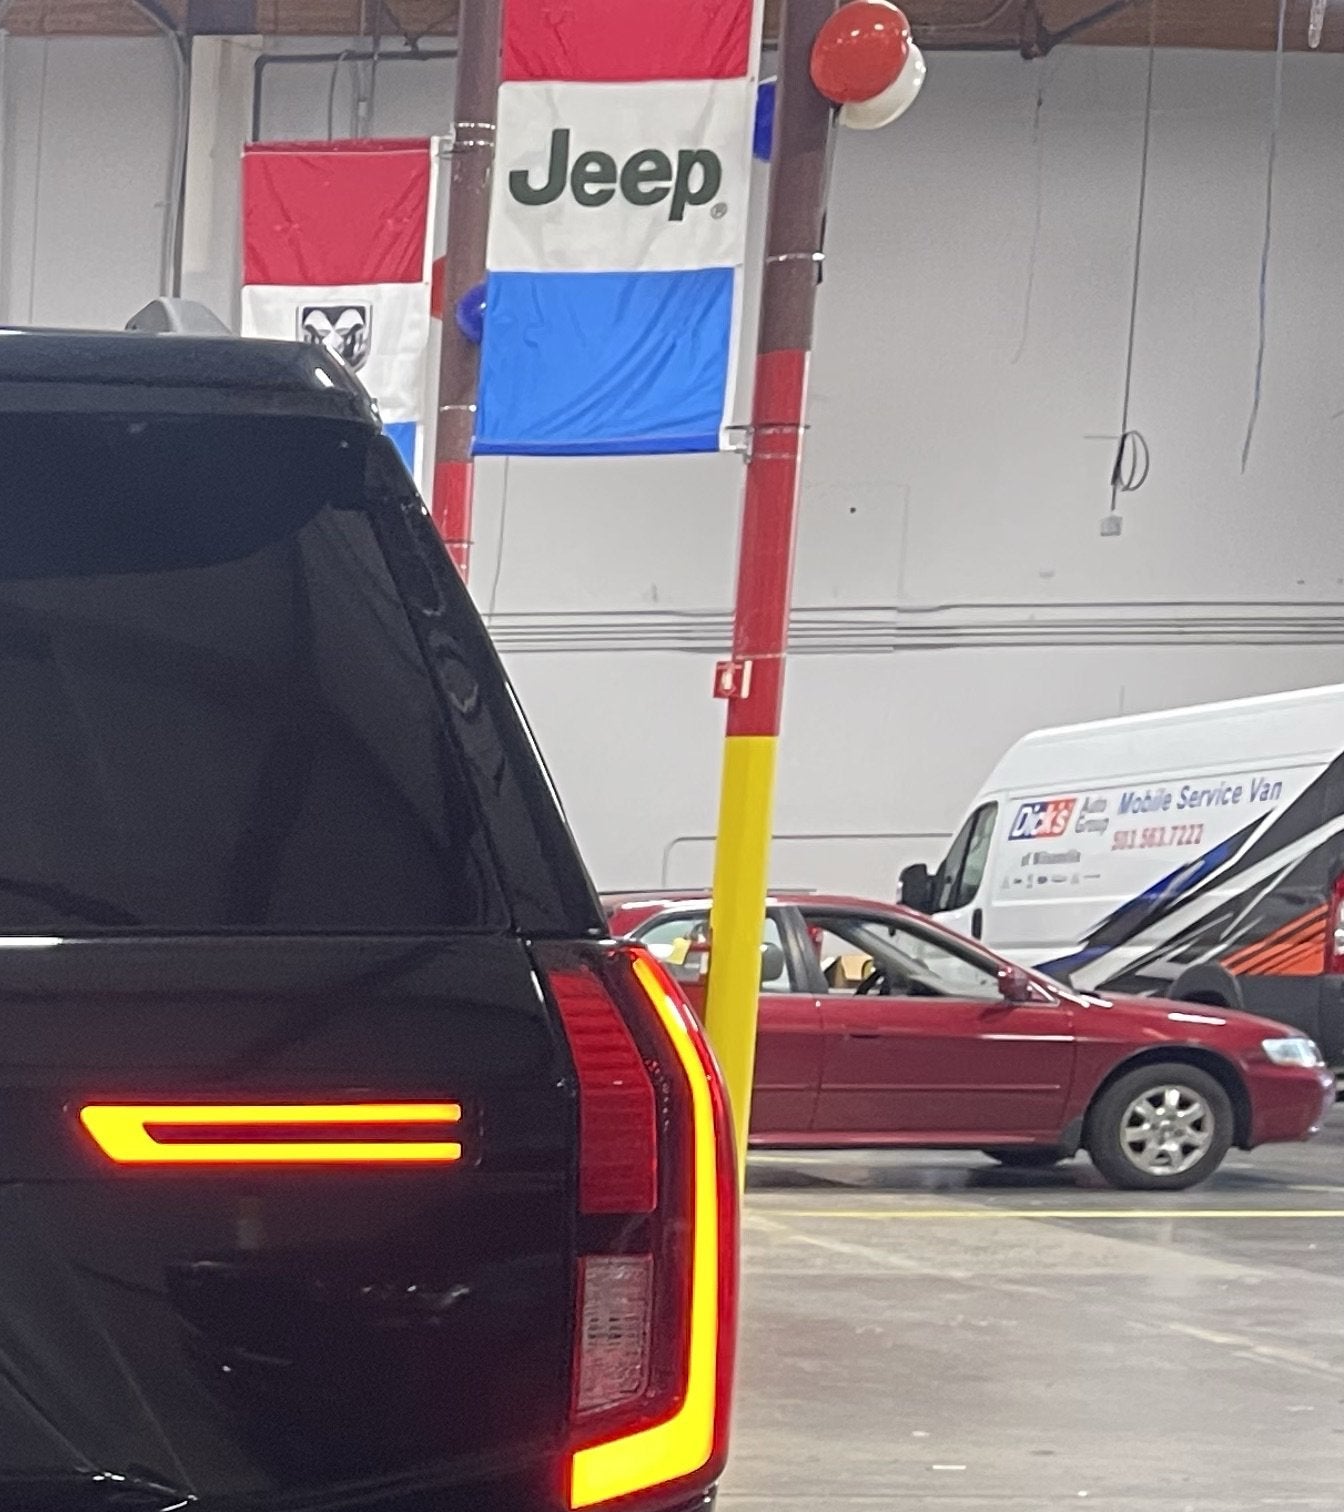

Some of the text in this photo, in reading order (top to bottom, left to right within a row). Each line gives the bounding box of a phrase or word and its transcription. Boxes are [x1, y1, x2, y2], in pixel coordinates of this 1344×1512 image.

[507, 128, 721, 222] Jeep
[1176, 784, 1243, 810] Service
[1249, 777, 1283, 803] Van
